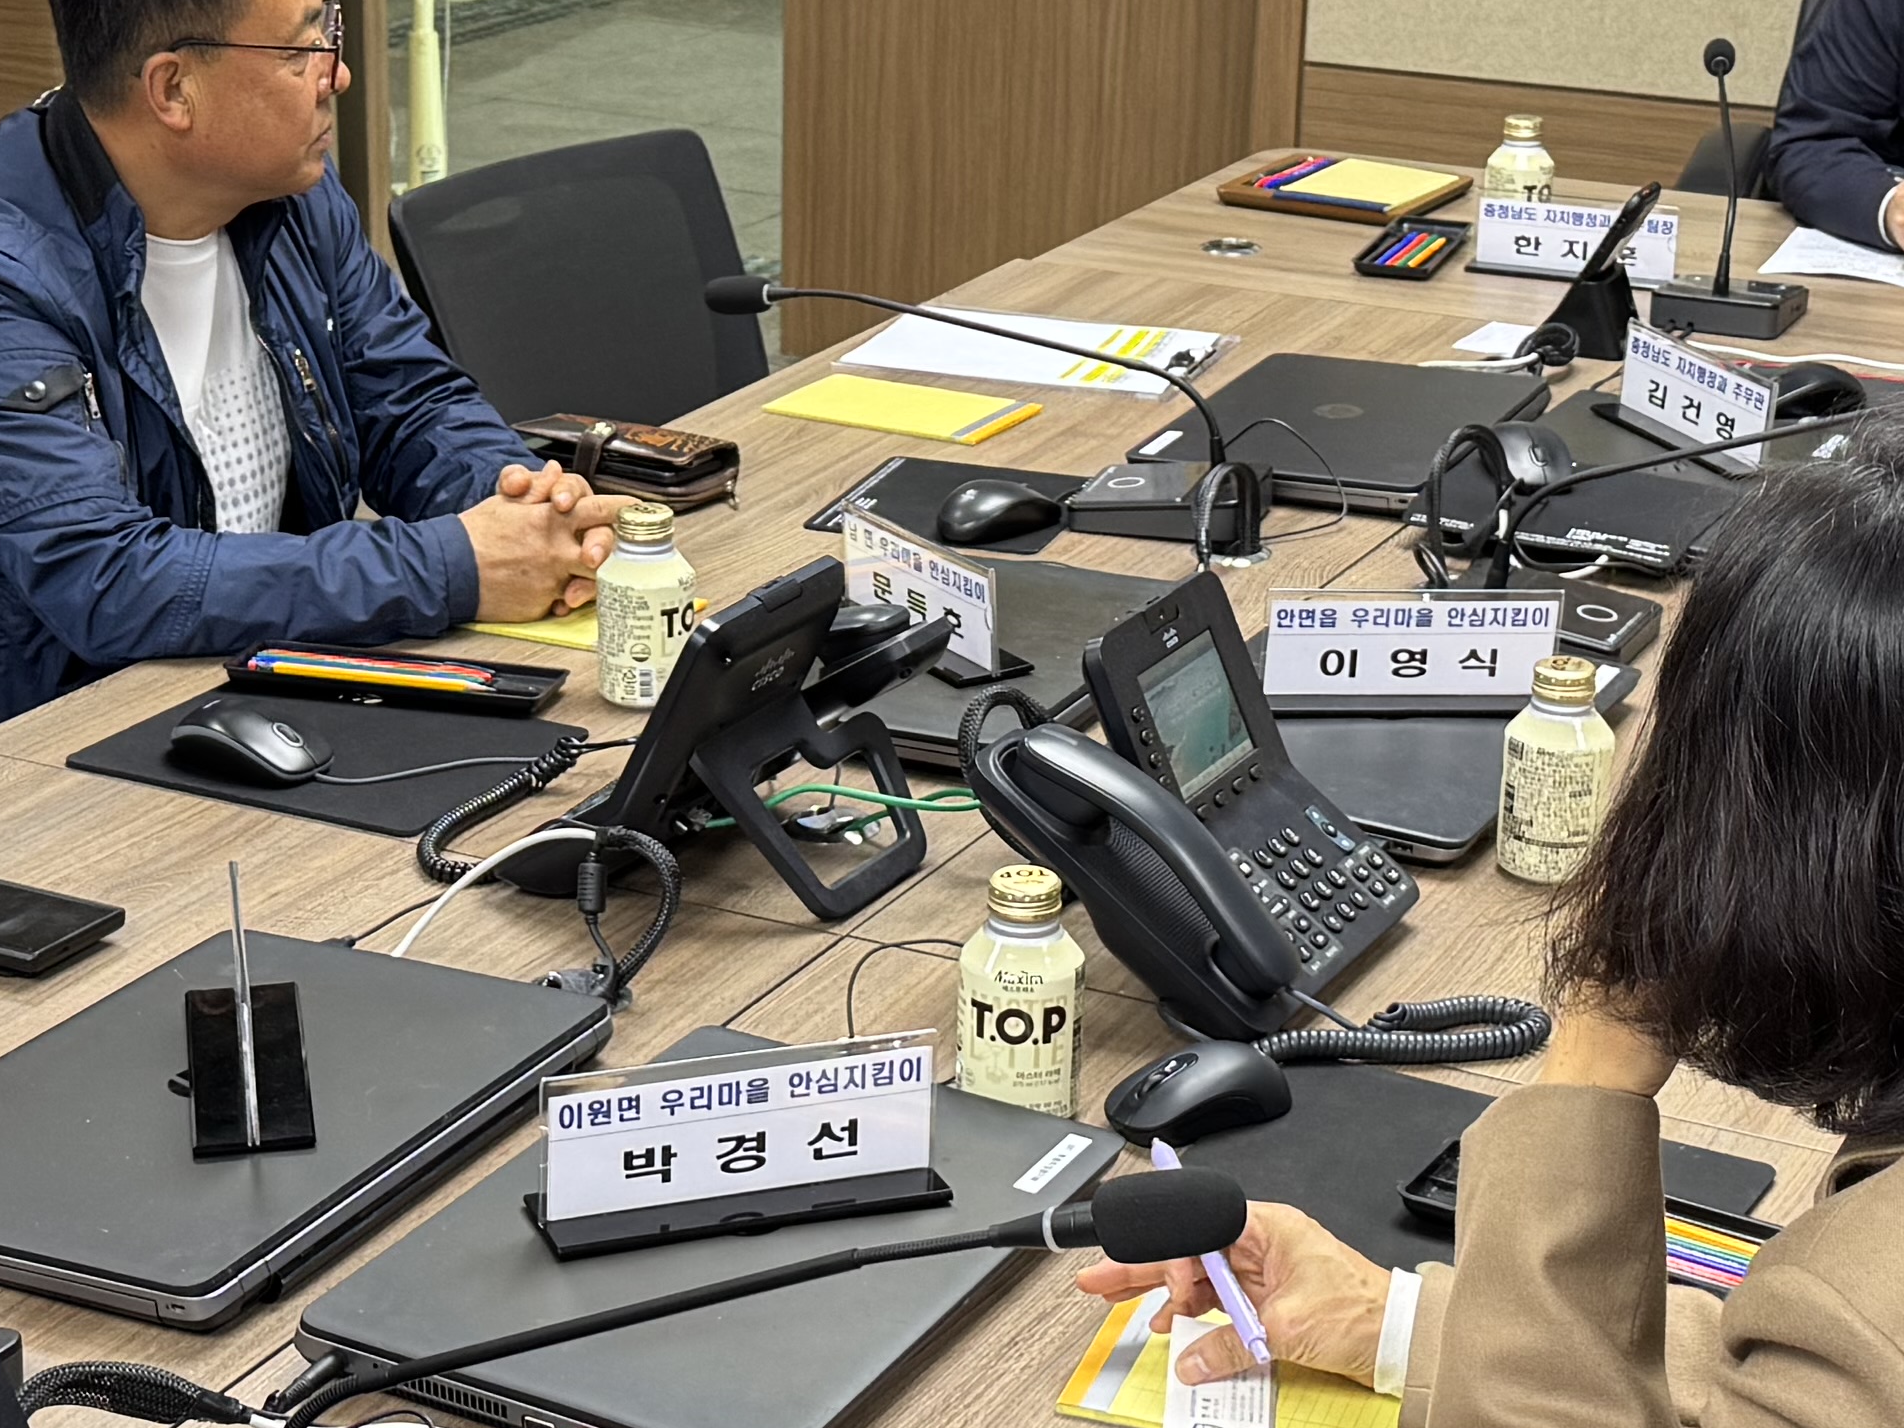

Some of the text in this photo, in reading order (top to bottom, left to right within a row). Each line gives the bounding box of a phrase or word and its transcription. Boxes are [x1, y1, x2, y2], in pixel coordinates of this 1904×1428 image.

[1483, 203, 1537, 221] 충청남도
[1544, 210, 1611, 229] 자치행정과
[1631, 337, 1765, 411] 충청남도 자치행정과 주무관
[929, 559, 985, 603] 안심지킴이
[1276, 607, 1549, 629] 안면읍 우리마을 안심지킴이
[994, 970, 1043, 985] Maxim
[971, 997, 1066, 1045] T.O.P
[558, 1056, 922, 1130] 이원면 우리마을 안심지킴이
